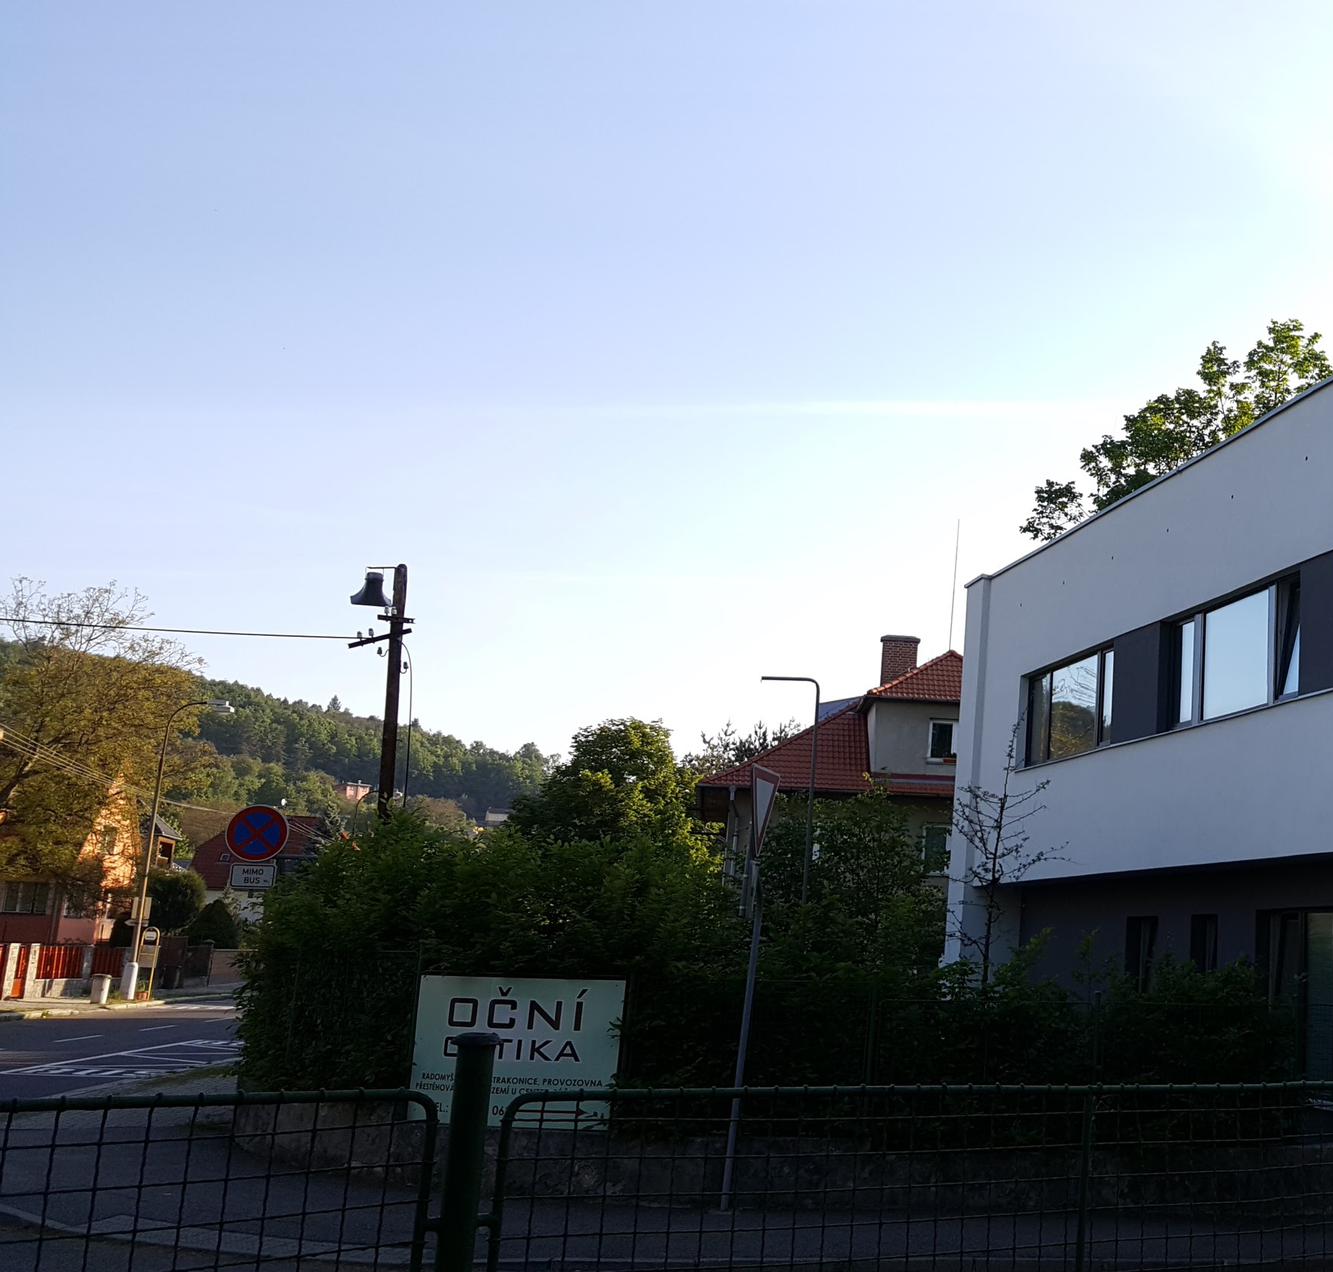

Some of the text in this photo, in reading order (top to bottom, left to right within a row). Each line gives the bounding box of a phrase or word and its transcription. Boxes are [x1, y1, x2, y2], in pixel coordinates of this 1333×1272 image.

[242, 868, 264, 876] MIMO
[448, 986, 588, 1031] OČNÍ
[443, 1037, 580, 1063] OTIKA
[422, 1072, 602, 1087] RADOMYŠ TRAKONICE, PROVOZOVNA
[491, 1085, 509, 1095] ZEMÍ
